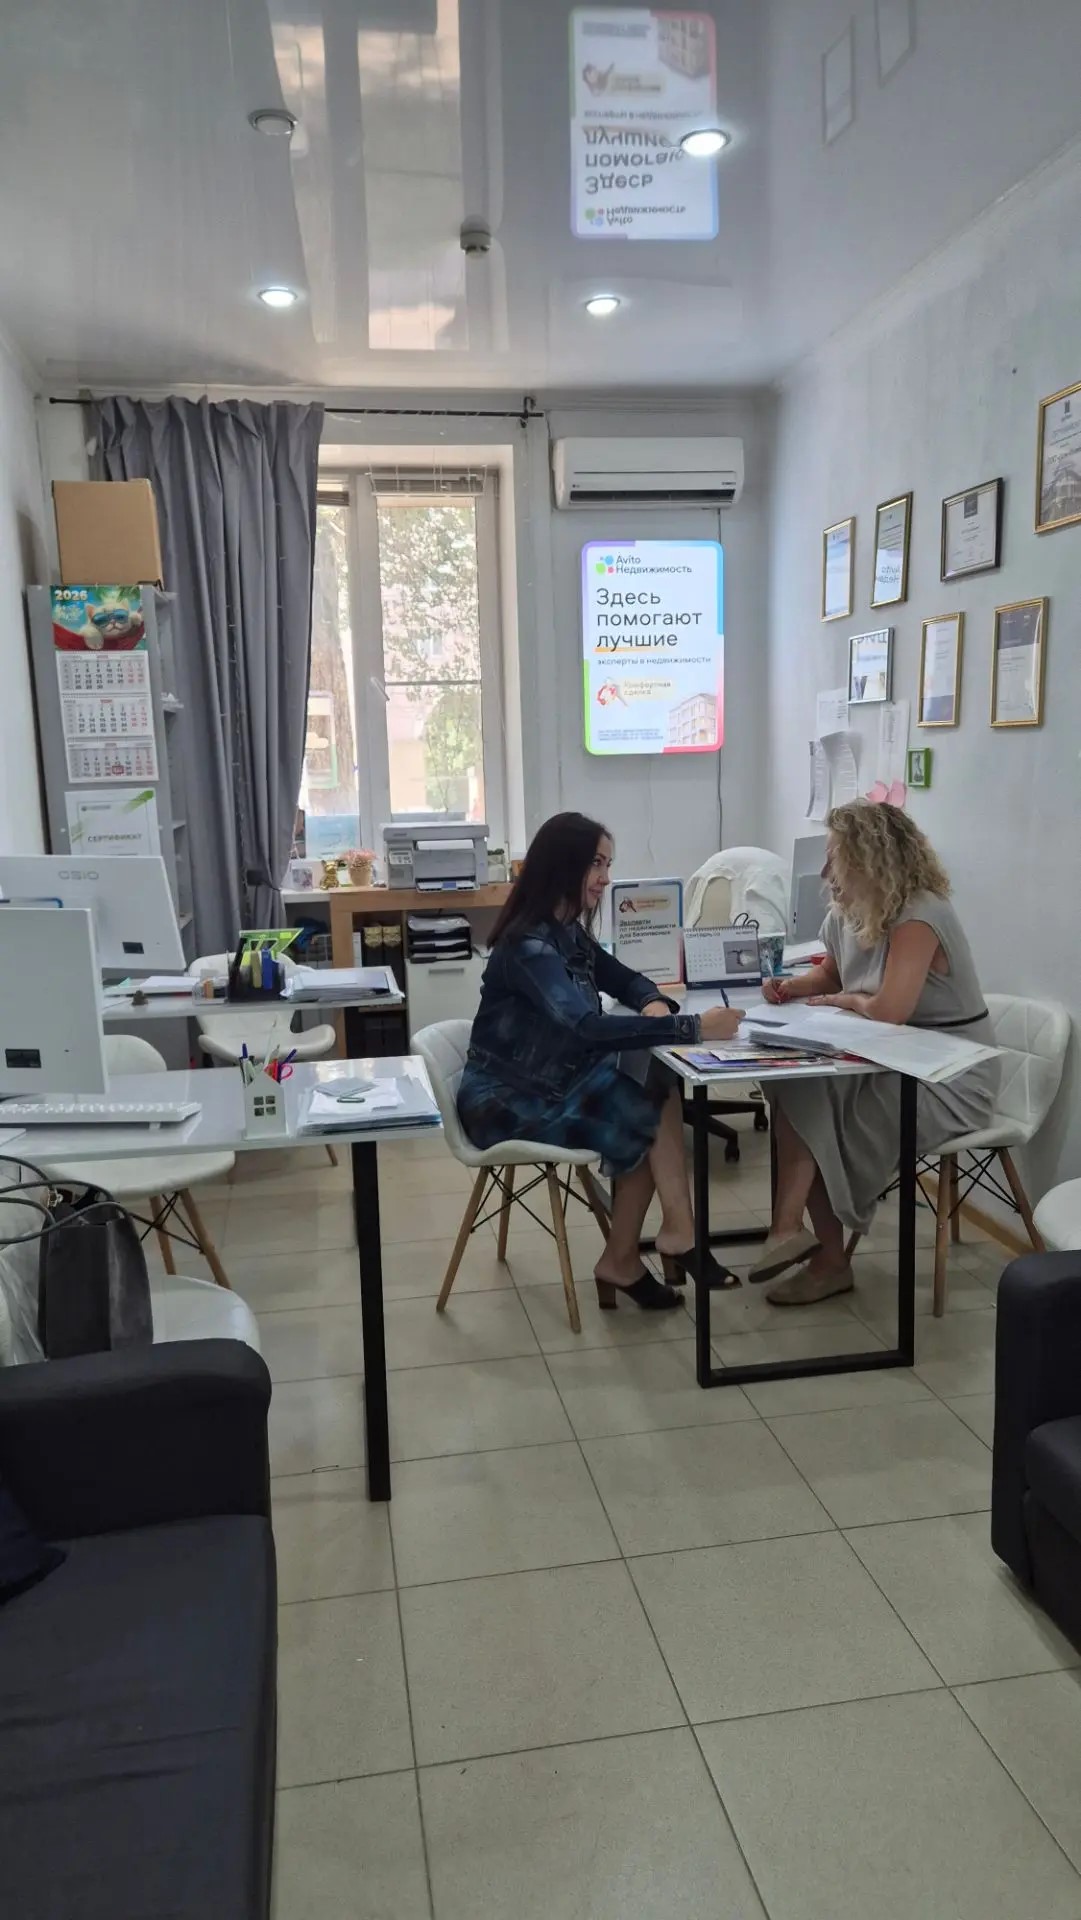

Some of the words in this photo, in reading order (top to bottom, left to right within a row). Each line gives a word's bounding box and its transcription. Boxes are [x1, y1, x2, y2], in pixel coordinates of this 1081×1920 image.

[616, 555, 641, 564] Avito
[616, 565, 692, 574] Недвижимость
[54, 590, 88, 600] 2026
[596, 587, 661, 608] Здесь
[597, 612, 703, 627] помогают
[596, 633, 678, 652] лучшие
[597, 657, 639, 668] эксперты
[647, 656, 711, 665] недвижимости
